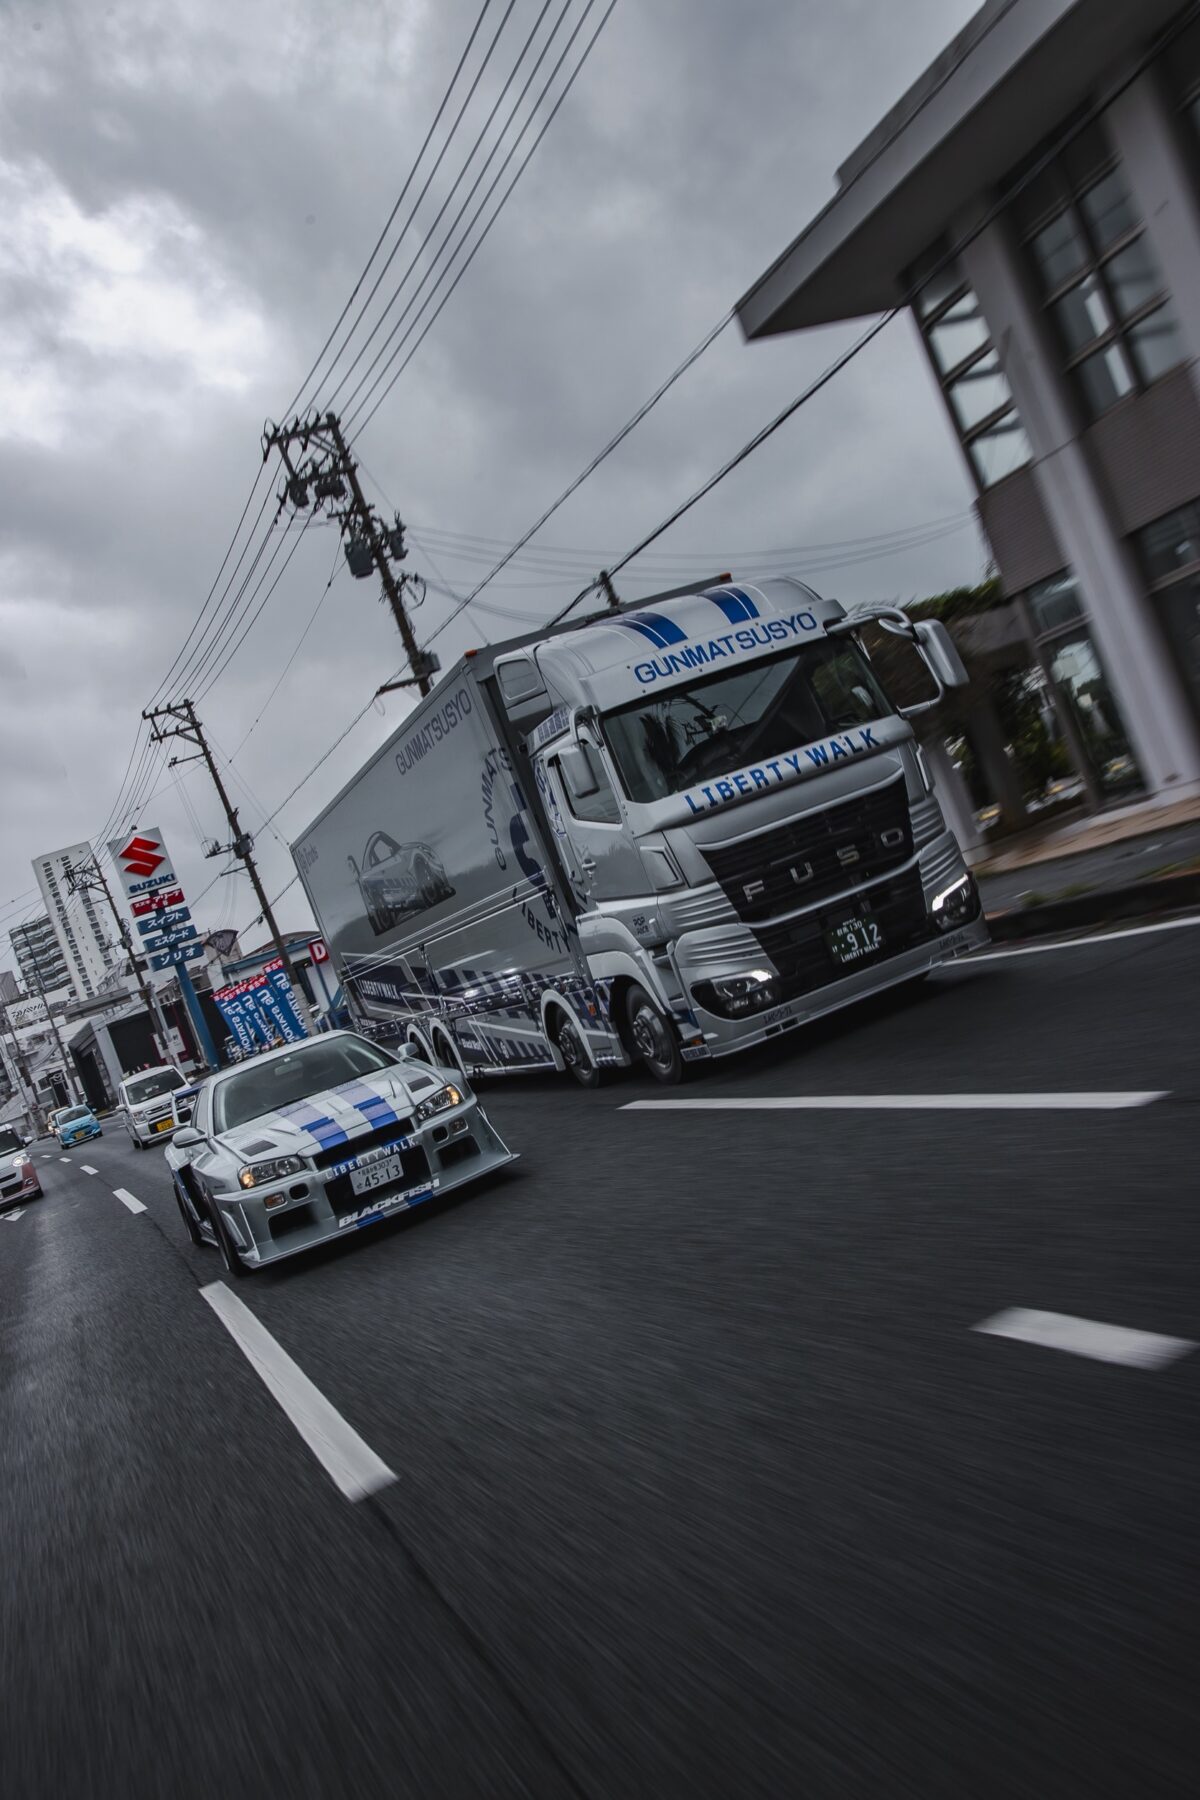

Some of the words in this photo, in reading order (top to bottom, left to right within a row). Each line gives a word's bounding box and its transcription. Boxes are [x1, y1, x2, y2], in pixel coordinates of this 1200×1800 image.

[634, 613, 818, 684] GUNMATSUSYO
[395, 688, 474, 776] GUNMATSUSYO
[685, 754, 801, 815] LIBERTY
[804, 728, 880, 769] WALK
[743, 828, 904, 902] FUSO
[128, 873, 176, 893] SUZUKI
[147, 911, 183, 929] スイフト
[154, 929, 189, 947] エスクード
[161, 946, 196, 966] ソリオ
[312, 943, 328, 960] D
[325, 1150, 380, 1180] LIBERTY
[382, 1138, 416, 1157] WALK
[377, 1160, 391, 1170] 303
[364, 1165, 400, 1188] 45-13
[339, 1178, 440, 1228] BLACKFISH
